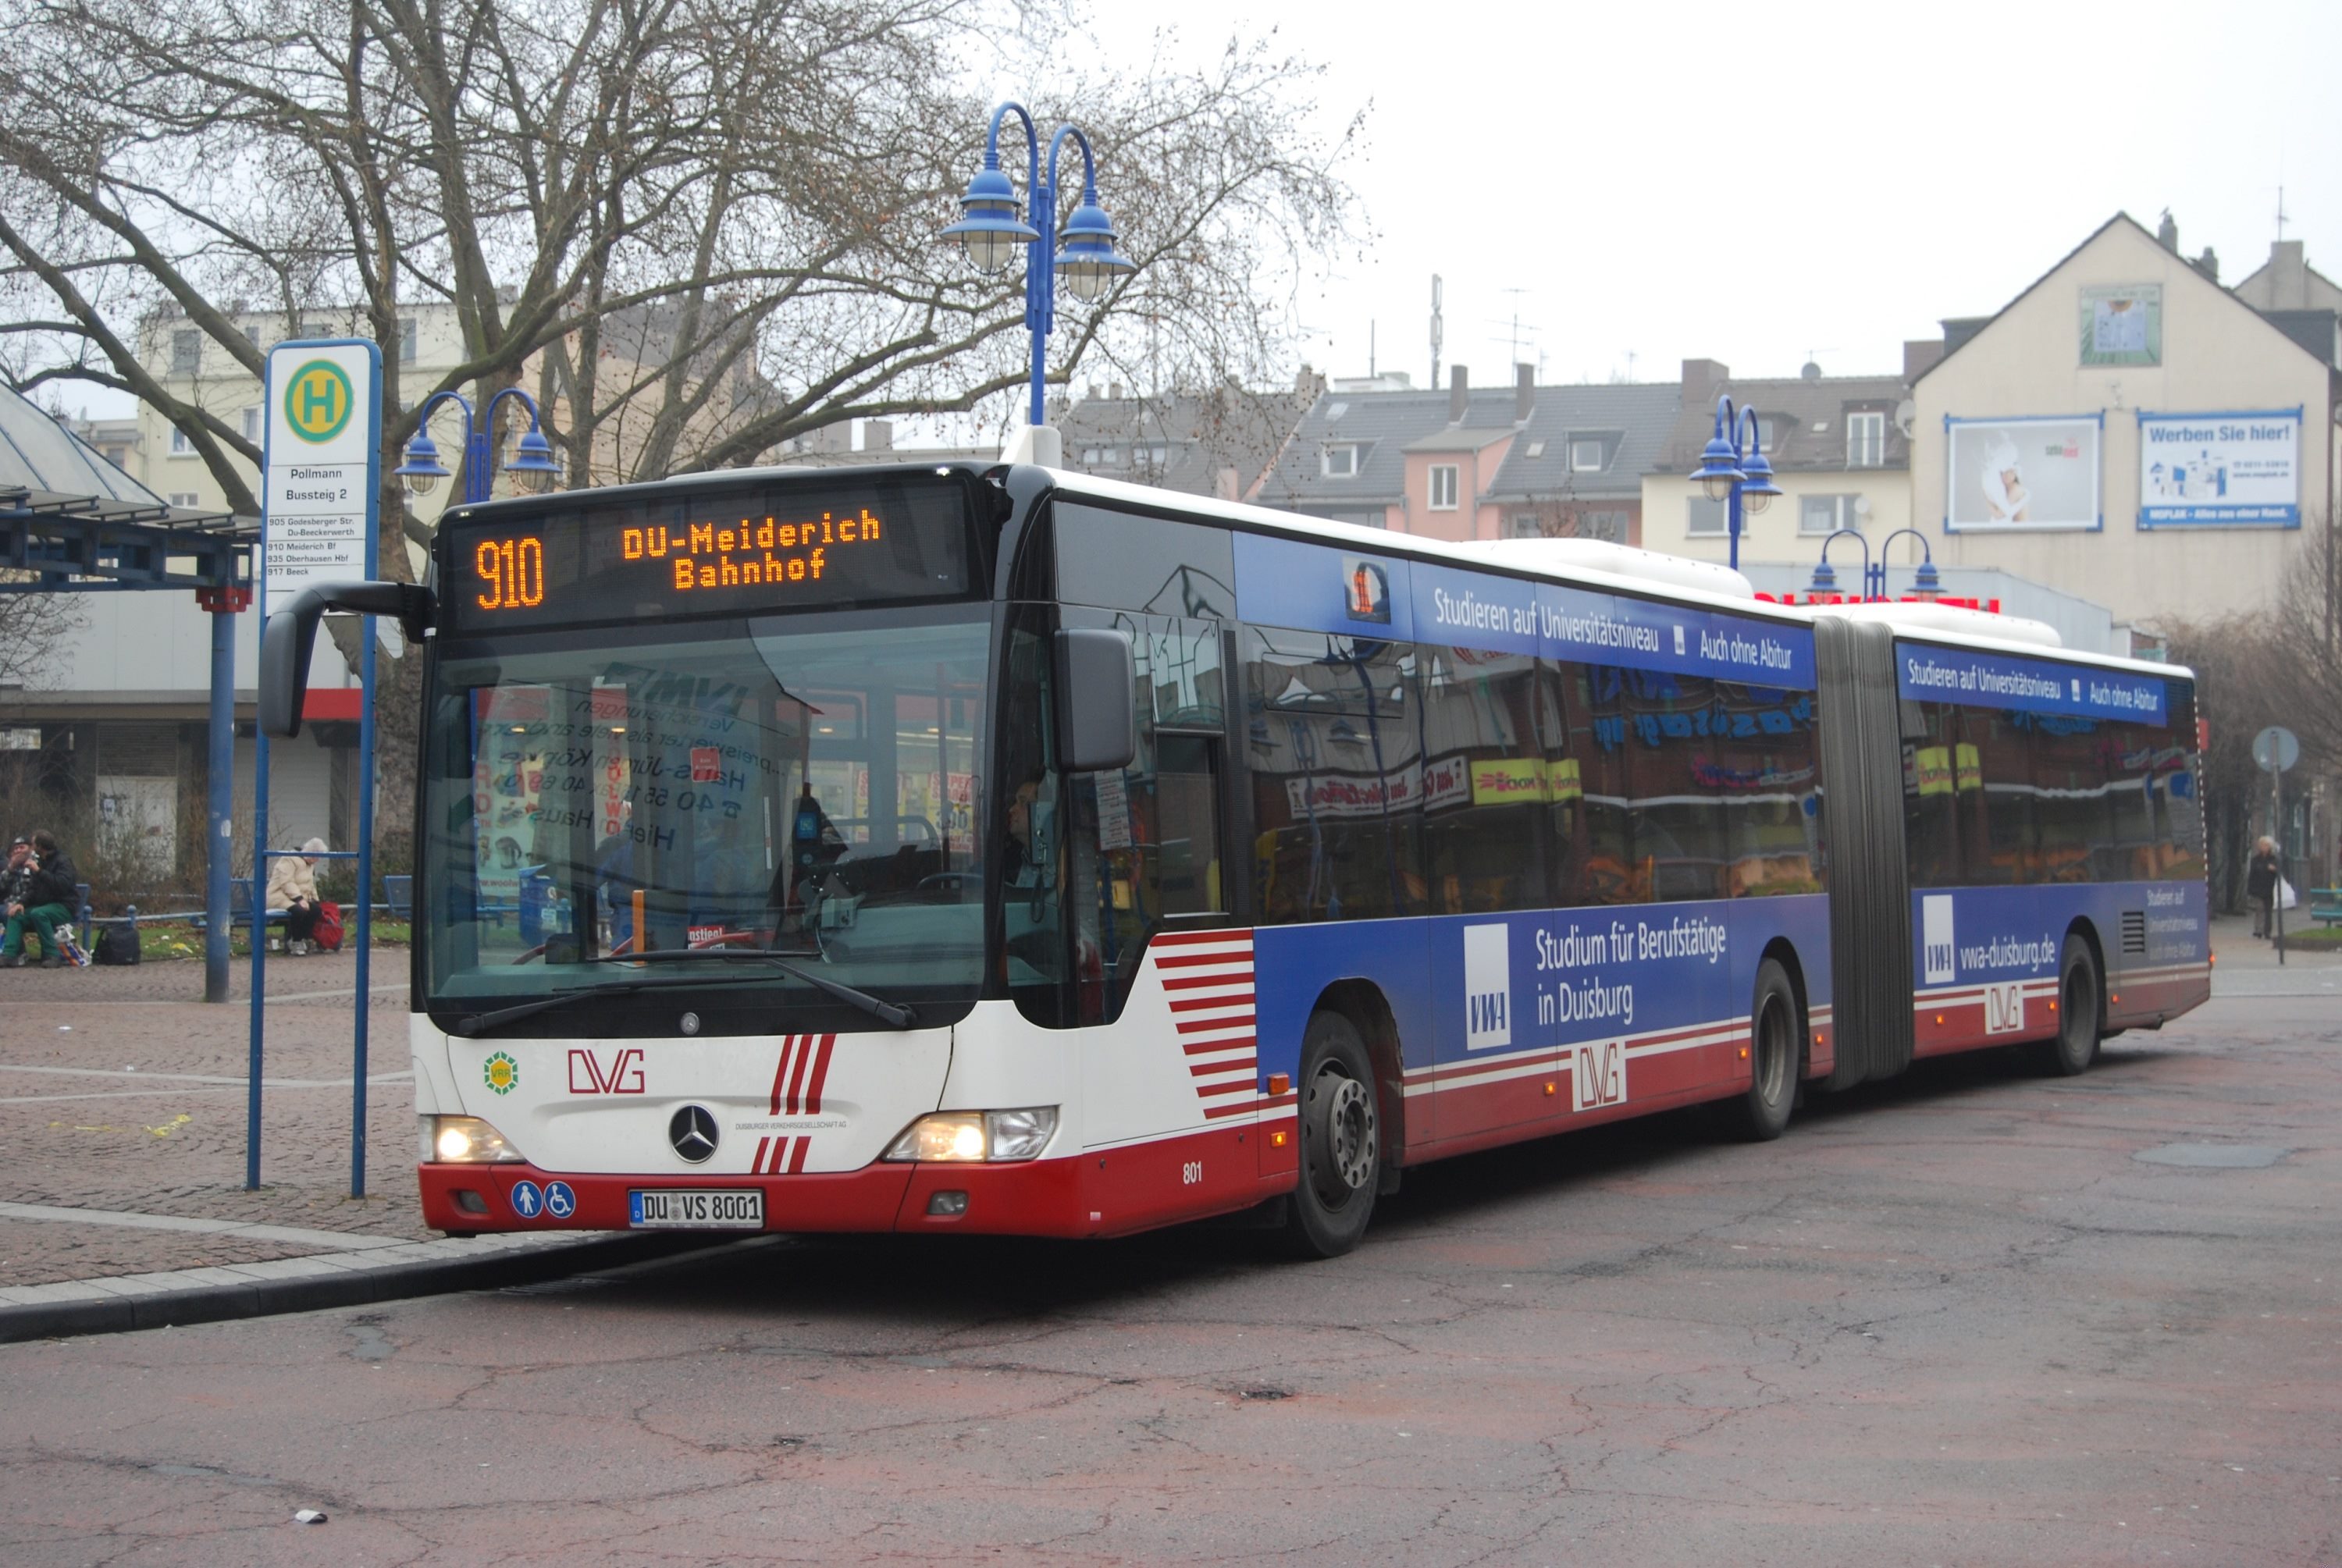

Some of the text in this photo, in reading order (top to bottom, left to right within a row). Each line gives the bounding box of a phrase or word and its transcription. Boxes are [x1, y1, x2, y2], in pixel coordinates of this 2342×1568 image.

[303, 379, 336, 425] H
[2150, 424, 2290, 443] Werben Sie hier!
[290, 468, 342, 479] Pollmann
[287, 489, 347, 503] Bussteig 2
[287, 517, 337, 527] Godesberger
[340, 517, 354, 525] Str.
[287, 528, 354, 537] Du-Beeckerwerth
[624, 509, 880, 560] DU-Meiderich
[287, 542, 324, 551] Meiderich
[327, 542, 336, 550] Bf
[268, 567, 309, 576] 917 Beeck
[476, 537, 543, 610] 910
[674, 547, 825, 589] Bahnhof
[1434, 587, 1792, 670] Studieren auf Universitätsniveau Auch ohne Abitur
[1908, 658, 2158, 712] Studieren auf Universitätsniveau Auch ohne Abitur
[1536, 916, 1726, 972] Studium für Berufstätige
[1928, 944, 1951, 972] VWA
[1960, 932, 2055, 972] vwa-duisburg.de
[1471, 992, 1506, 1034] VWA
[1538, 976, 1634, 1026] in Duisburg
[1991, 985, 2018, 1032] DVG
[490, 1068, 512, 1079] VRR
[568, 1049, 646, 1094] DVG
[1580, 1042, 1619, 1109] DVG
[771, 1121, 838, 1129] VERKEHRSGESELLSCHAFT
[1183, 1161, 1202, 1185] 801
[644, 1196, 668, 1220] DU
[682, 1196, 707, 1220] VS
[712, 1196, 760, 1220] 8001
